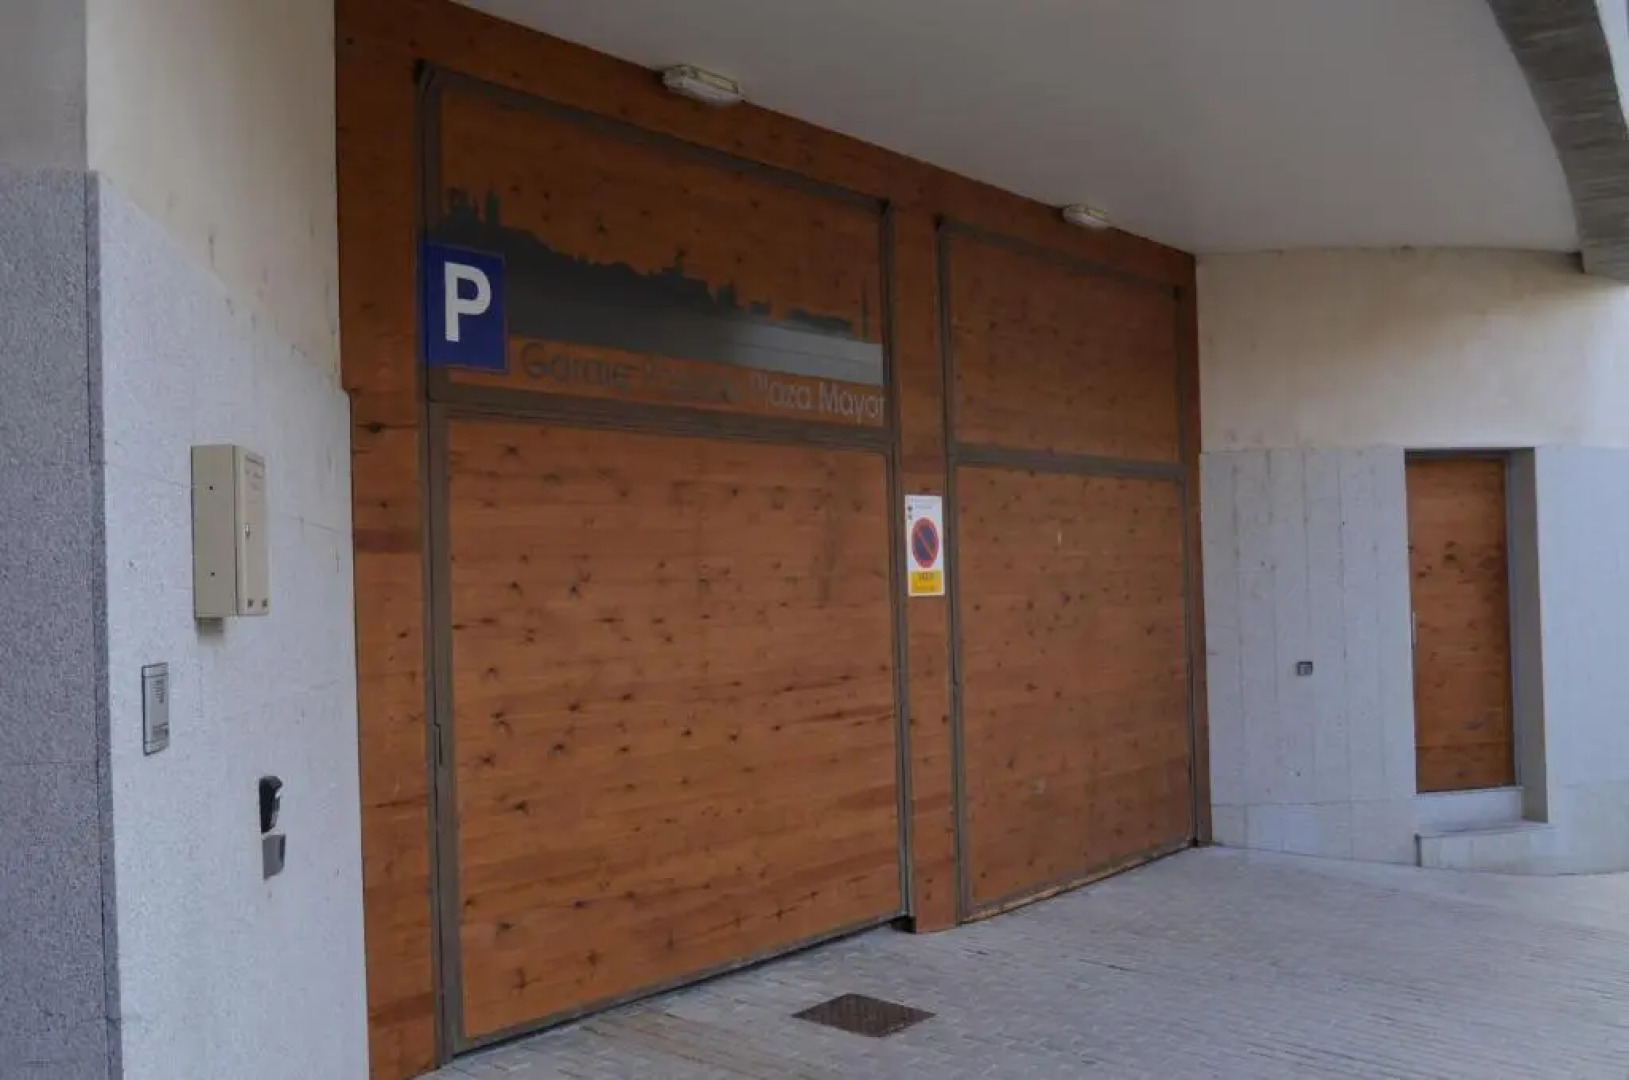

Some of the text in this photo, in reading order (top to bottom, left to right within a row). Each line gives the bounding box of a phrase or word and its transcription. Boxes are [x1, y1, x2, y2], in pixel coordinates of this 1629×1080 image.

[444, 261, 491, 342] P
[751, 371, 812, 410] Plaza
[819, 380, 885, 424] Mayor
